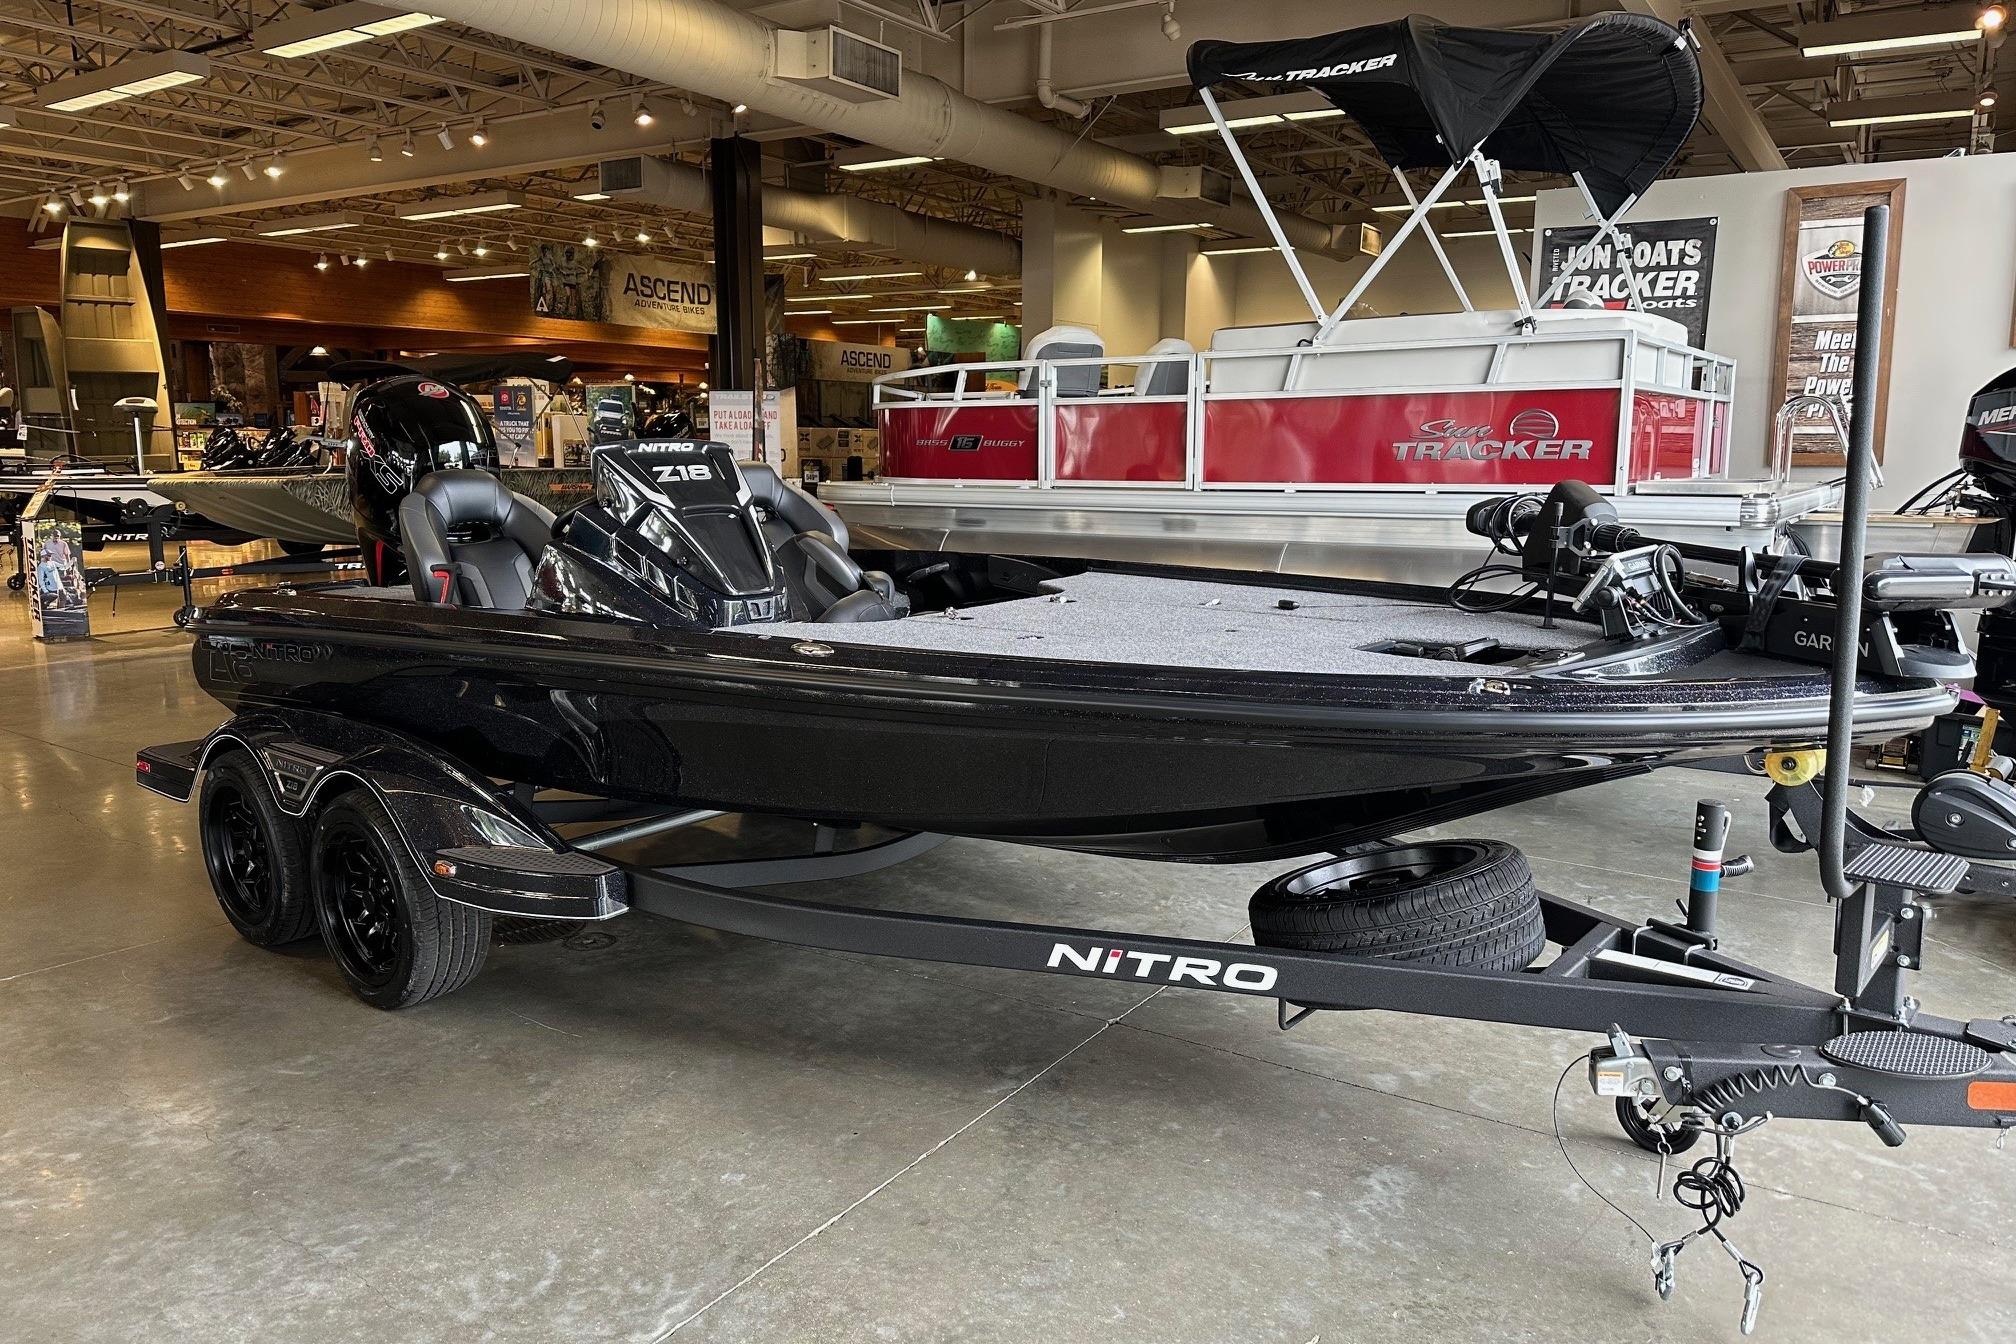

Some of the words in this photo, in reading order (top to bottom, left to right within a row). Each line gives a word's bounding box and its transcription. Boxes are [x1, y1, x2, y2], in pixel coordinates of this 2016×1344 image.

[1285, 53, 1398, 81] TRACKER
[1551, 248, 1560, 272] RIVETED
[1560, 244, 1612, 271] JON
[623, 272, 712, 306] ASCEND
[634, 298, 681, 313] ADVENTURE
[682, 305, 706, 315] BIKES
[840, 350, 892, 369] ASCEND
[1819, 352, 1851, 373] The
[713, 411, 727, 419] PUT
[728, 411, 733, 419] A
[734, 411, 752, 419] LOAD
[714, 422, 732, 430] TAKE
[733, 422, 739, 430] A
[740, 422, 753, 430] LOA
[1409, 419, 1494, 439] Sun
[638, 443, 695, 453] NITRO
[1393, 439, 1593, 461] TRACKER
[652, 465, 712, 482] Z18
[27, 537, 41, 621] TRACKER
[1794, 631, 1869, 658] GARN
[276, 758, 307, 775] NITRO
